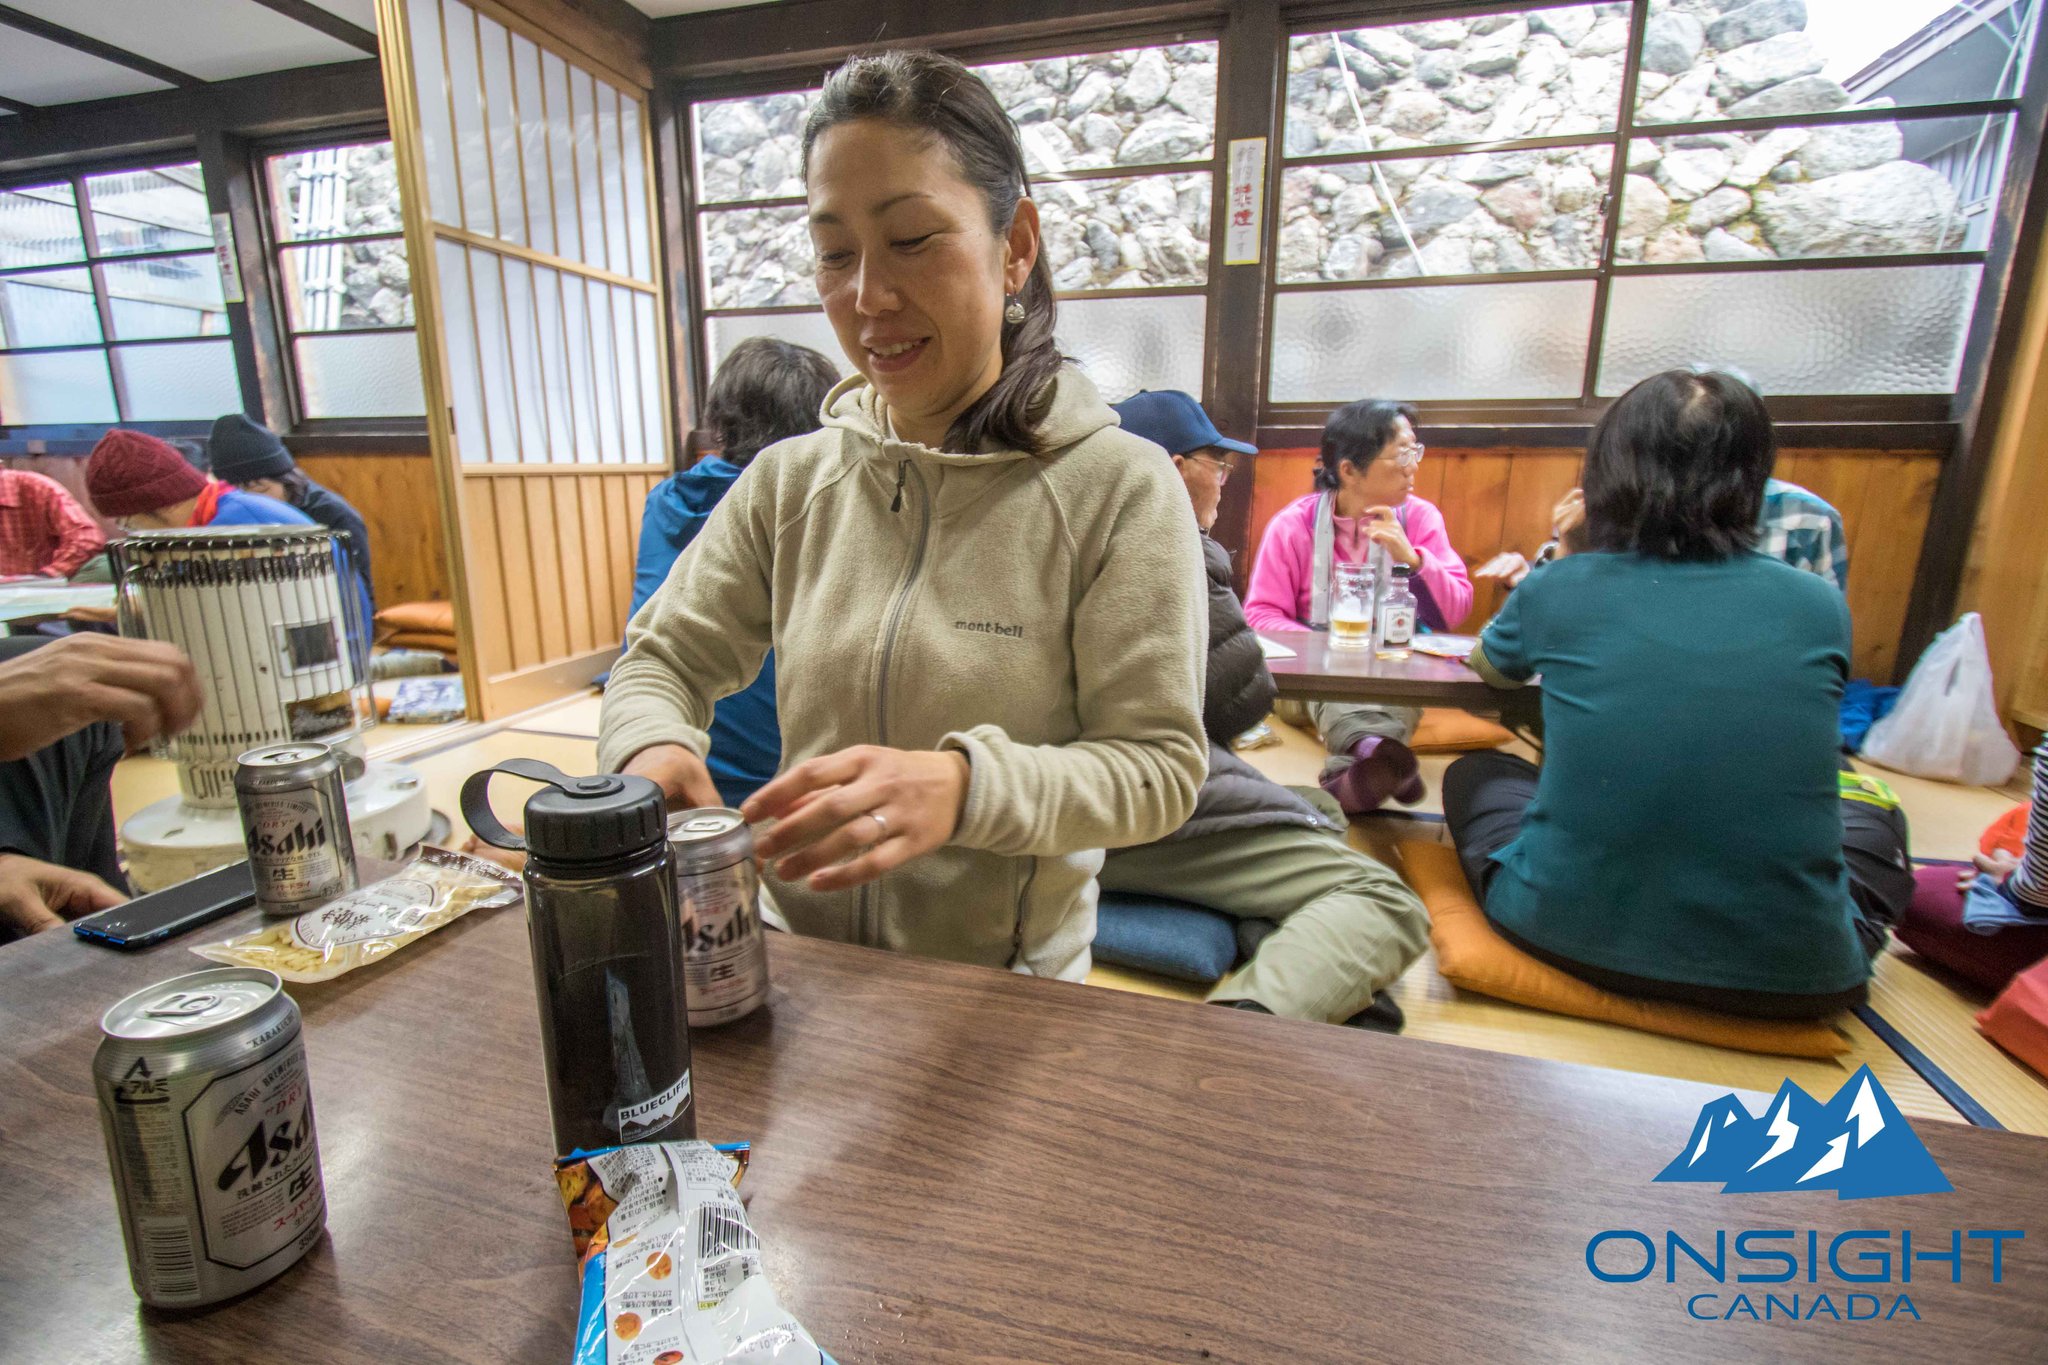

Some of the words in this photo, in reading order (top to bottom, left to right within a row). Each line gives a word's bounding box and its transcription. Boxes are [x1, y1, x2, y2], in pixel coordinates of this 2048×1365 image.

[247, 816, 327, 857] Asahi
[271, 867, 297, 882] 生
[709, 963, 736, 983] 生
[130, 1078, 169, 1094] アルミ
[234, 1088, 261, 1116] ASAHI
[288, 1165, 316, 1202] 生
